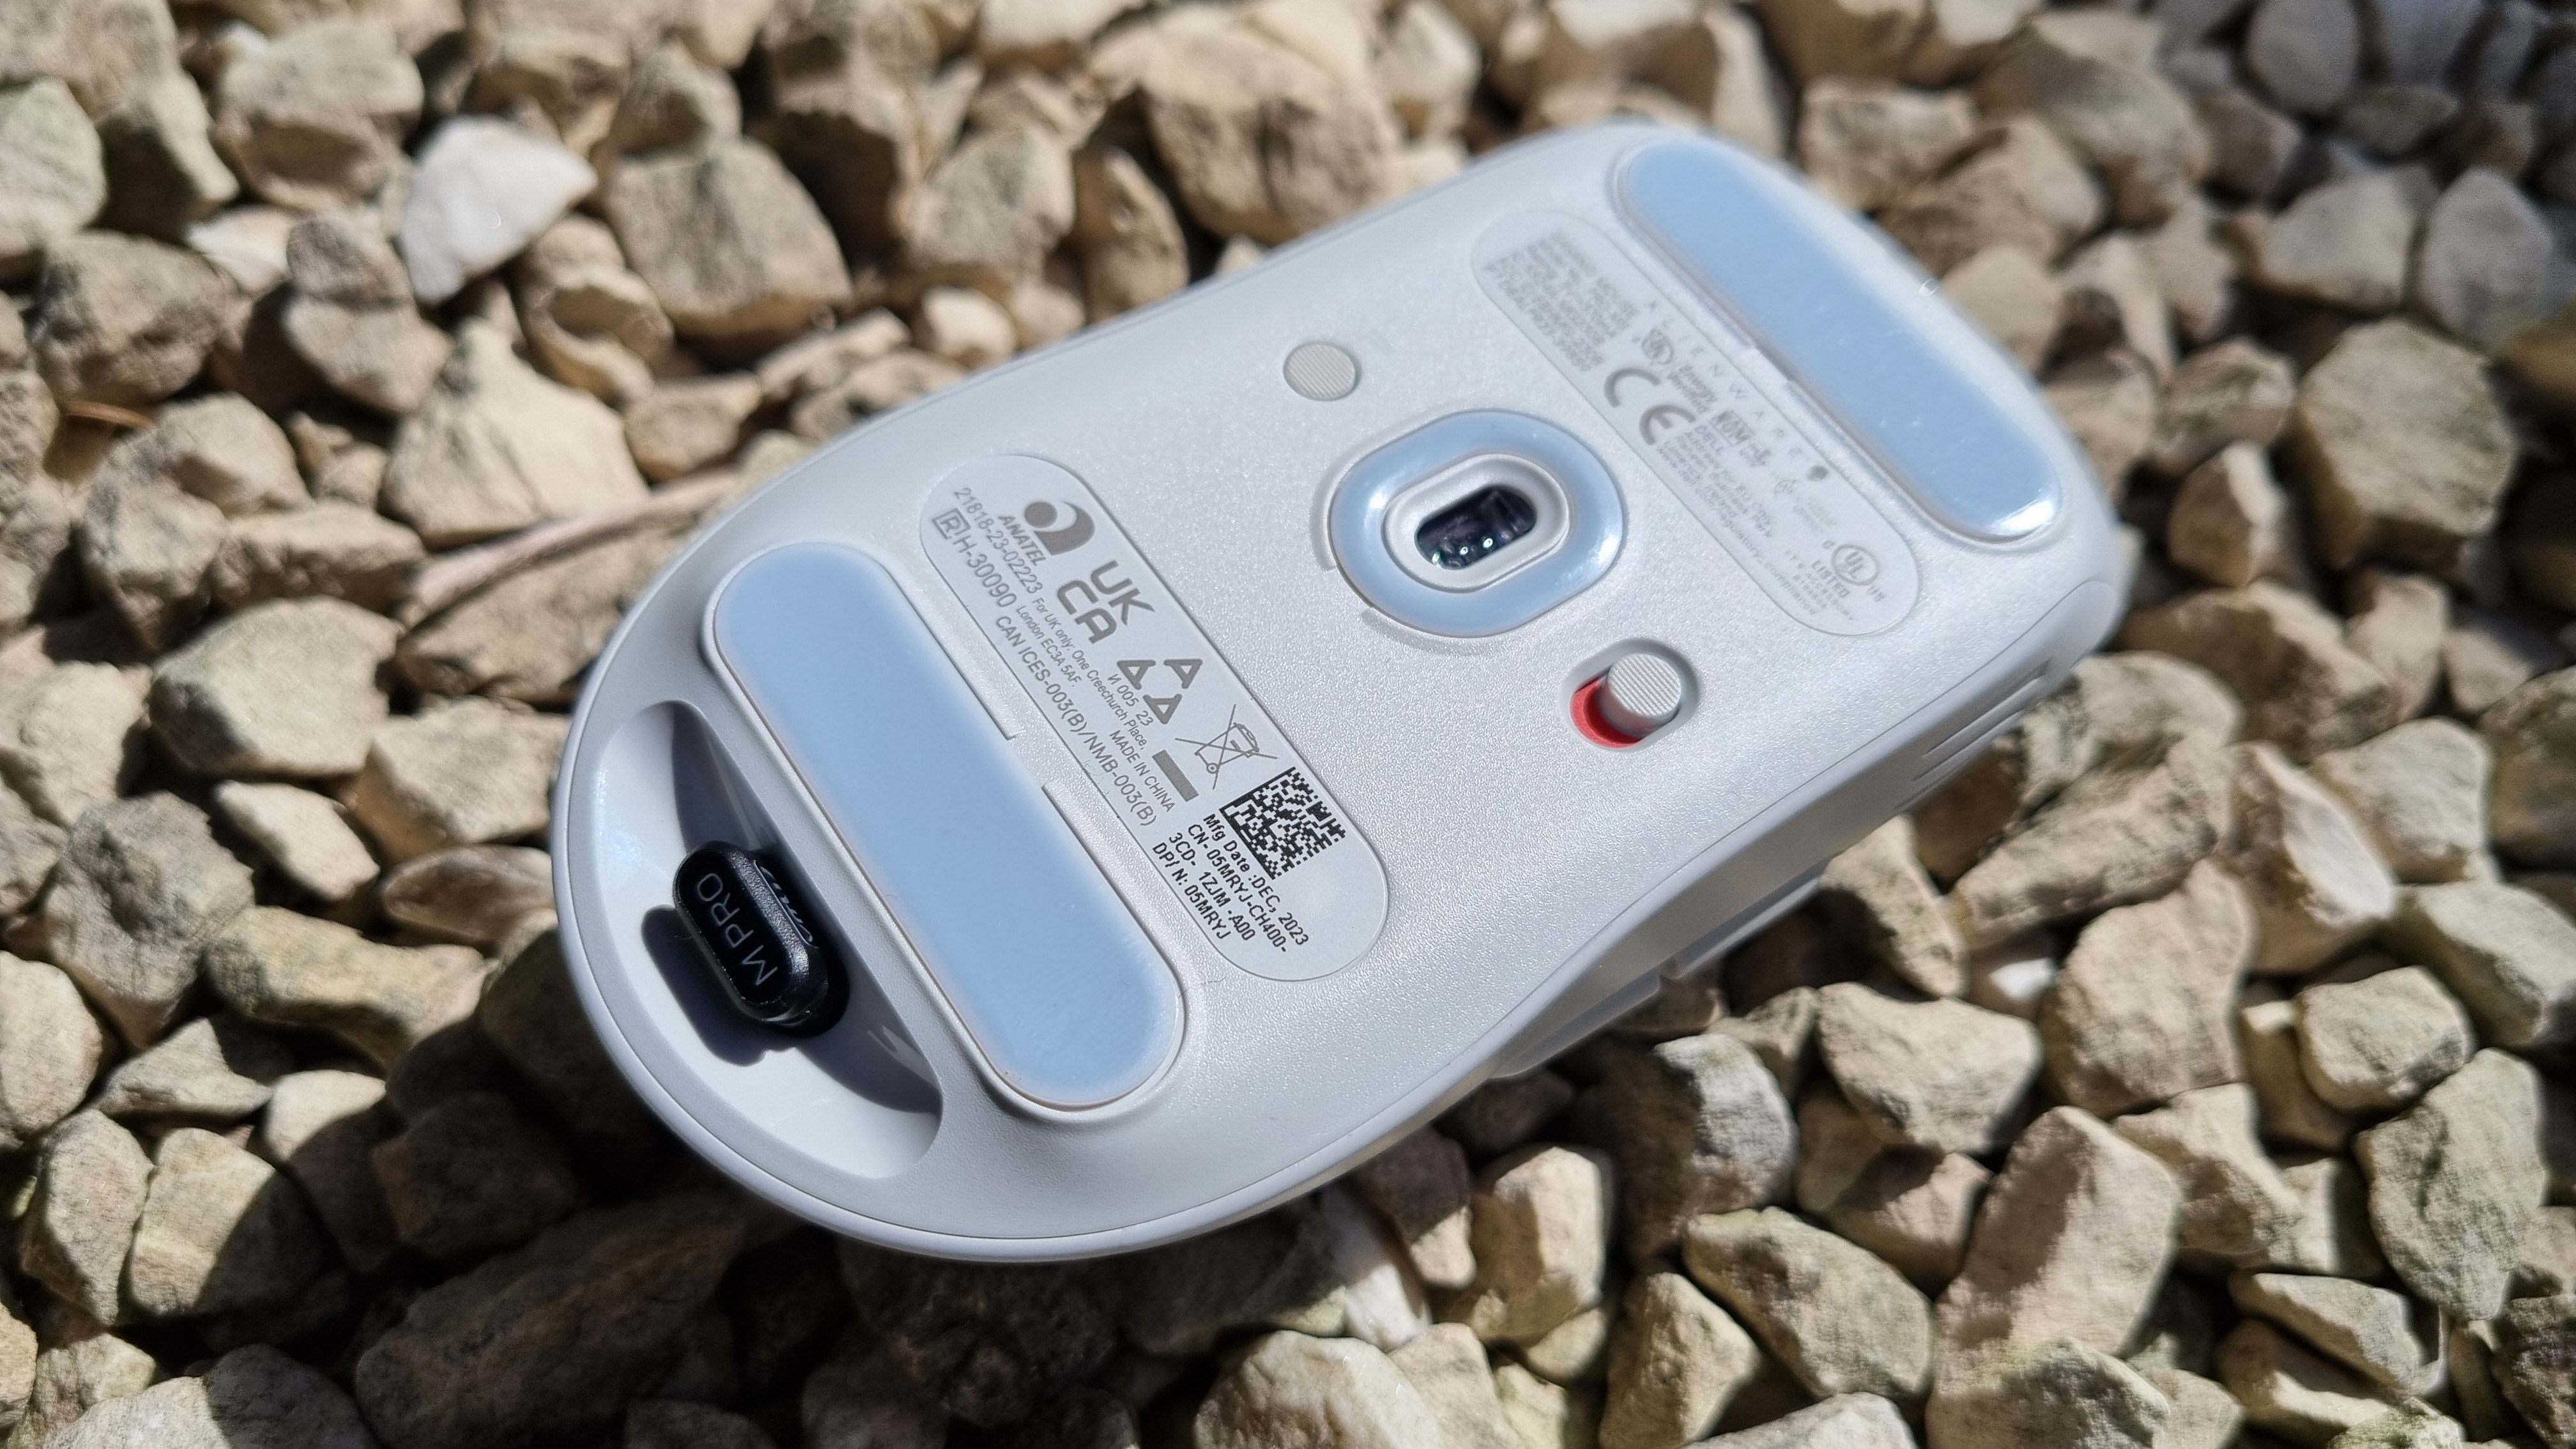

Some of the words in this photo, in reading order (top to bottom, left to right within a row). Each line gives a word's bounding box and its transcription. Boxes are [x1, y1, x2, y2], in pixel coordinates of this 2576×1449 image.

[1603, 365, 1696, 445] CE
[1693, 424, 1724, 455] DELL
[951, 534, 1017, 608] H-30090
[953, 486, 1043, 594] 21818-23-02223
[997, 515, 1046, 566] ANATEL
[1055, 579, 1117, 644] CA
[1089, 559, 1155, 626] UK
[1810, 559, 1851, 599] LISTED
[1015, 604, 1045, 640] London
[1039, 637, 1066, 666] EC3A
[1031, 597, 1048, 613] For
[1043, 613, 1062, 630] UK
[1071, 649, 1090, 670] One
[1085, 669, 1128, 721] Creechurch
[1123, 718, 1147, 750] Place,
[1116, 684, 1140, 707] 005
[1134, 709, 1154, 726] 23
[995, 615, 1026, 647] CAN
[1017, 646, 1157, 826] ICES-003(B)/NMB-003(B)
[1108, 729, 1140, 764] MADE
[1133, 761, 1151, 777] IN
[1144, 775, 1176, 813] CHINA
[1168, 831, 1196, 866] 3CD-
[1198, 871, 1231, 907] 1ZJM
[1170, 867, 1188, 885] N:
[1183, 884, 1231, 939] 05MRYJ
[1187, 823, 1209, 849] CN-
[1206, 848, 1287, 952] 05MRYJ-CH400-
[1202, 813, 1226, 841] Mfg
[1222, 839, 1250, 873] Date
[1277, 911, 1309, 946] 2023
[697, 872, 754, 948] PRO
[742, 945, 778, 986] M
